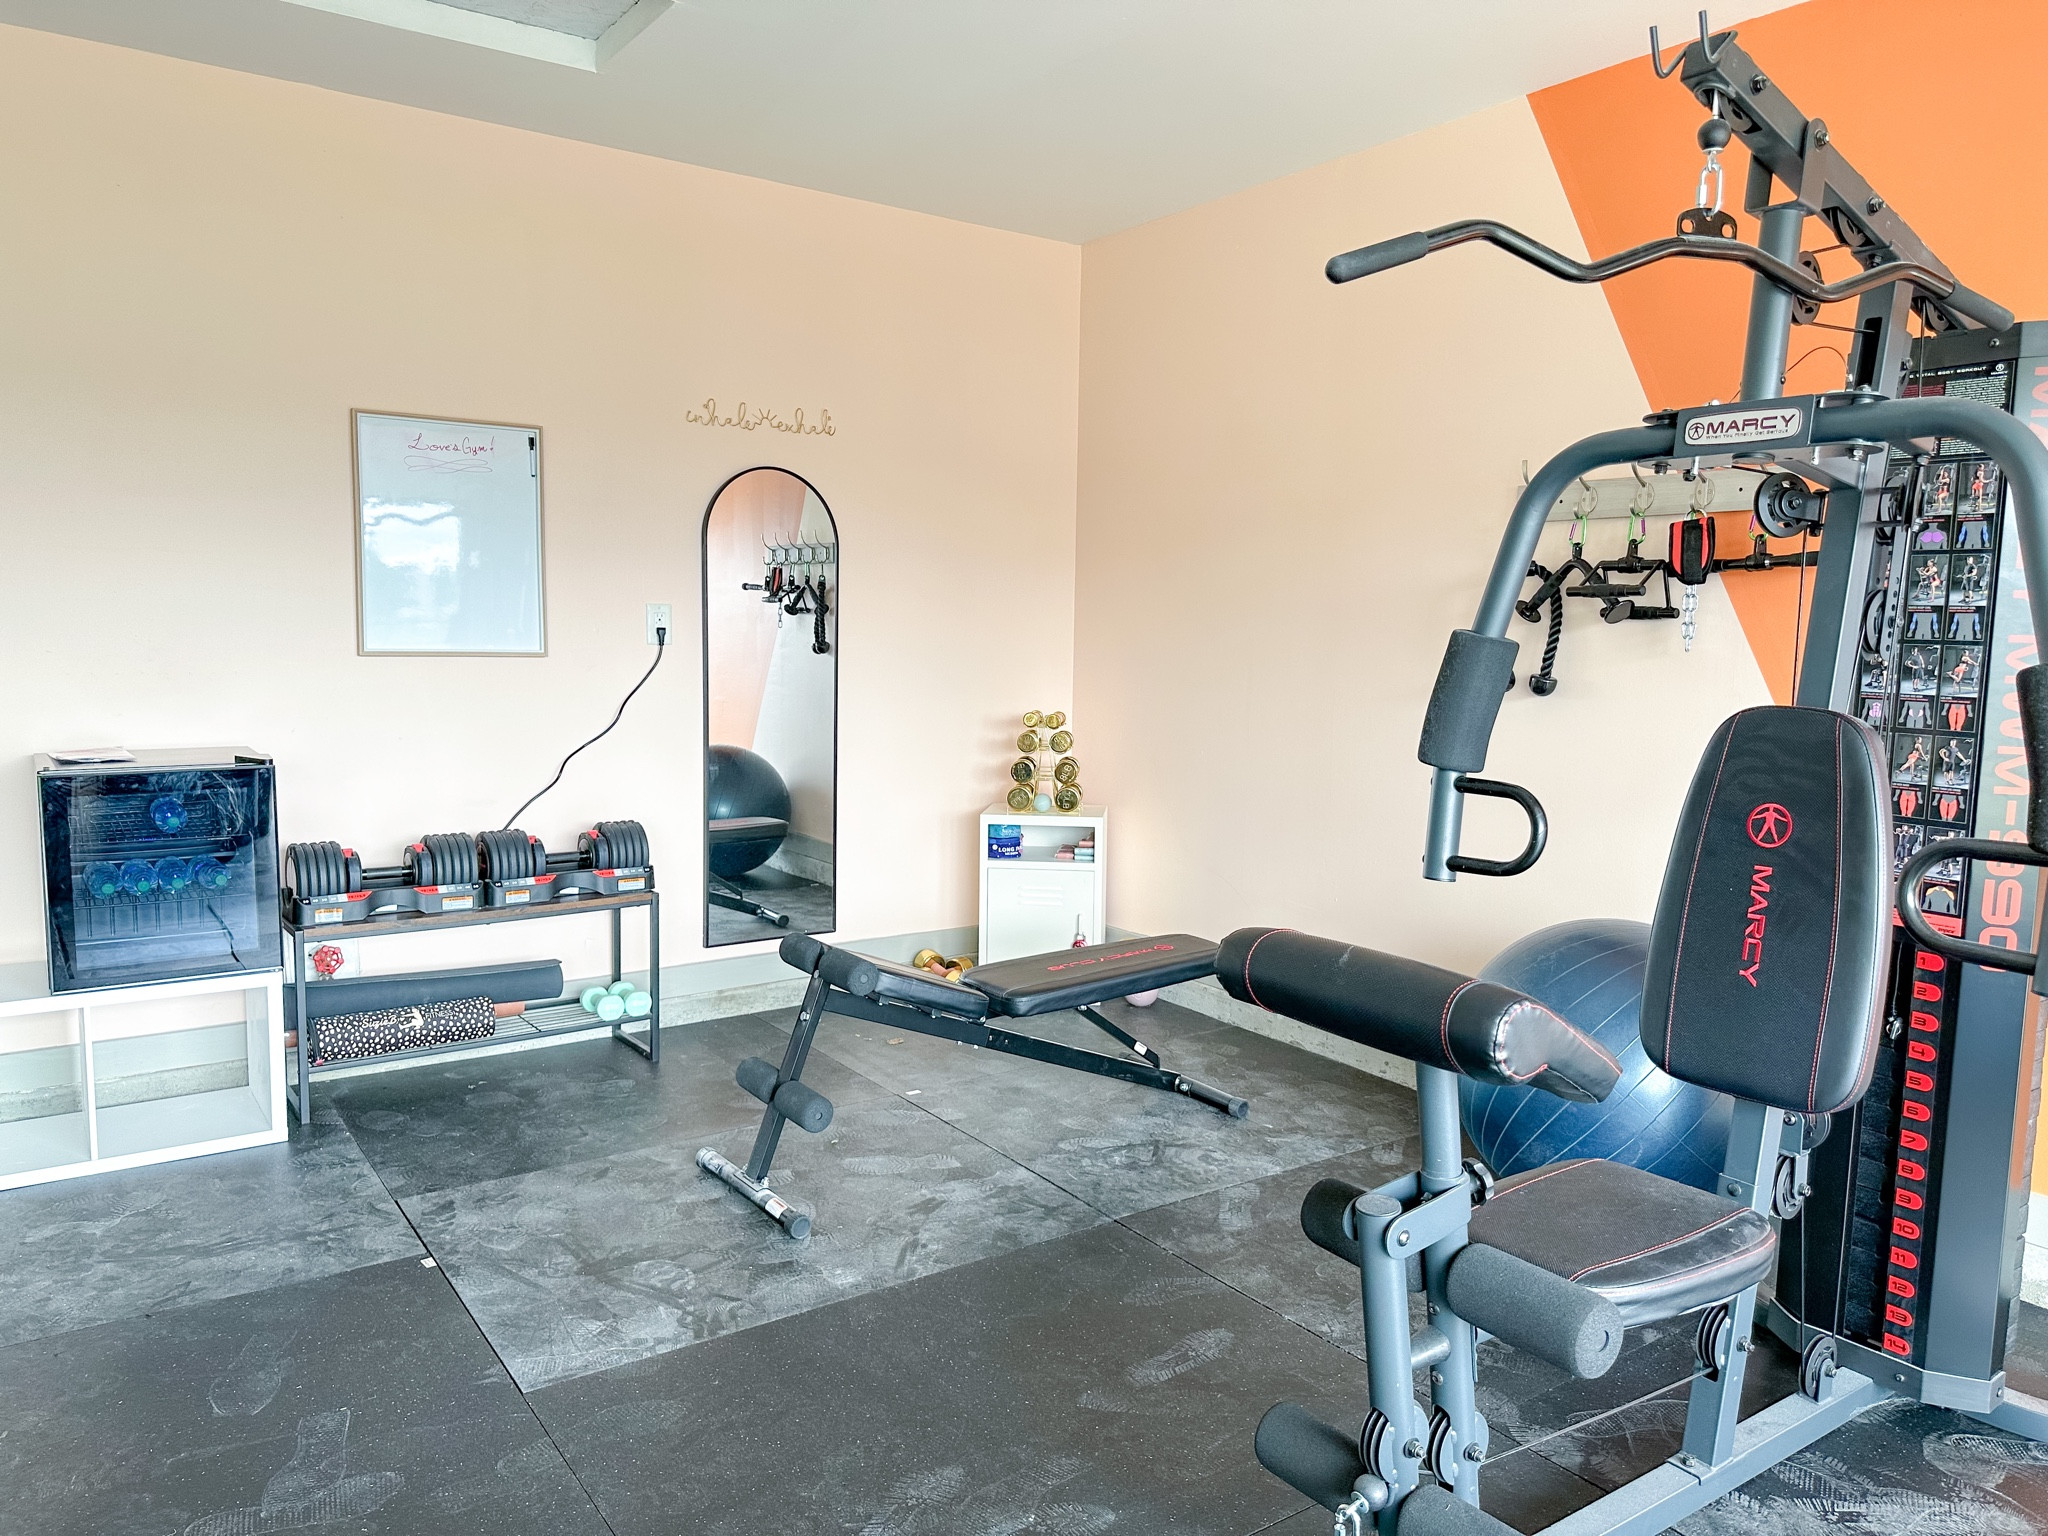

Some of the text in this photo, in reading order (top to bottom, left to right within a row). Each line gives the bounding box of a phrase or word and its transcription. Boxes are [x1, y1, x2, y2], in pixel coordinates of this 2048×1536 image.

[1706, 413, 1796, 435] MARCY
[408, 432, 461, 452] Love's
[1738, 864, 1774, 988] MARCY
[1919, 956, 1926, 966] 1
[1916, 986, 1927, 997] 2
[425, 1009, 454, 1019] FITNESS
[1913, 1016, 1927, 1027] 3
[1911, 1046, 1926, 1057] 4
[1908, 1075, 1922, 1087] 5
[1906, 1105, 1919, 1116] 6
[1904, 1134, 1917, 1144] 7
[1901, 1164, 1914, 1175] 8
[1898, 1193, 1912, 1205] 9
[1896, 1222, 1915, 1236] 10
[1894, 1252, 1906, 1263] 11
[1891, 1280, 1908, 1293] 12
[1889, 1309, 1908, 1323] 13
[1887, 1338, 1907, 1352] 14
